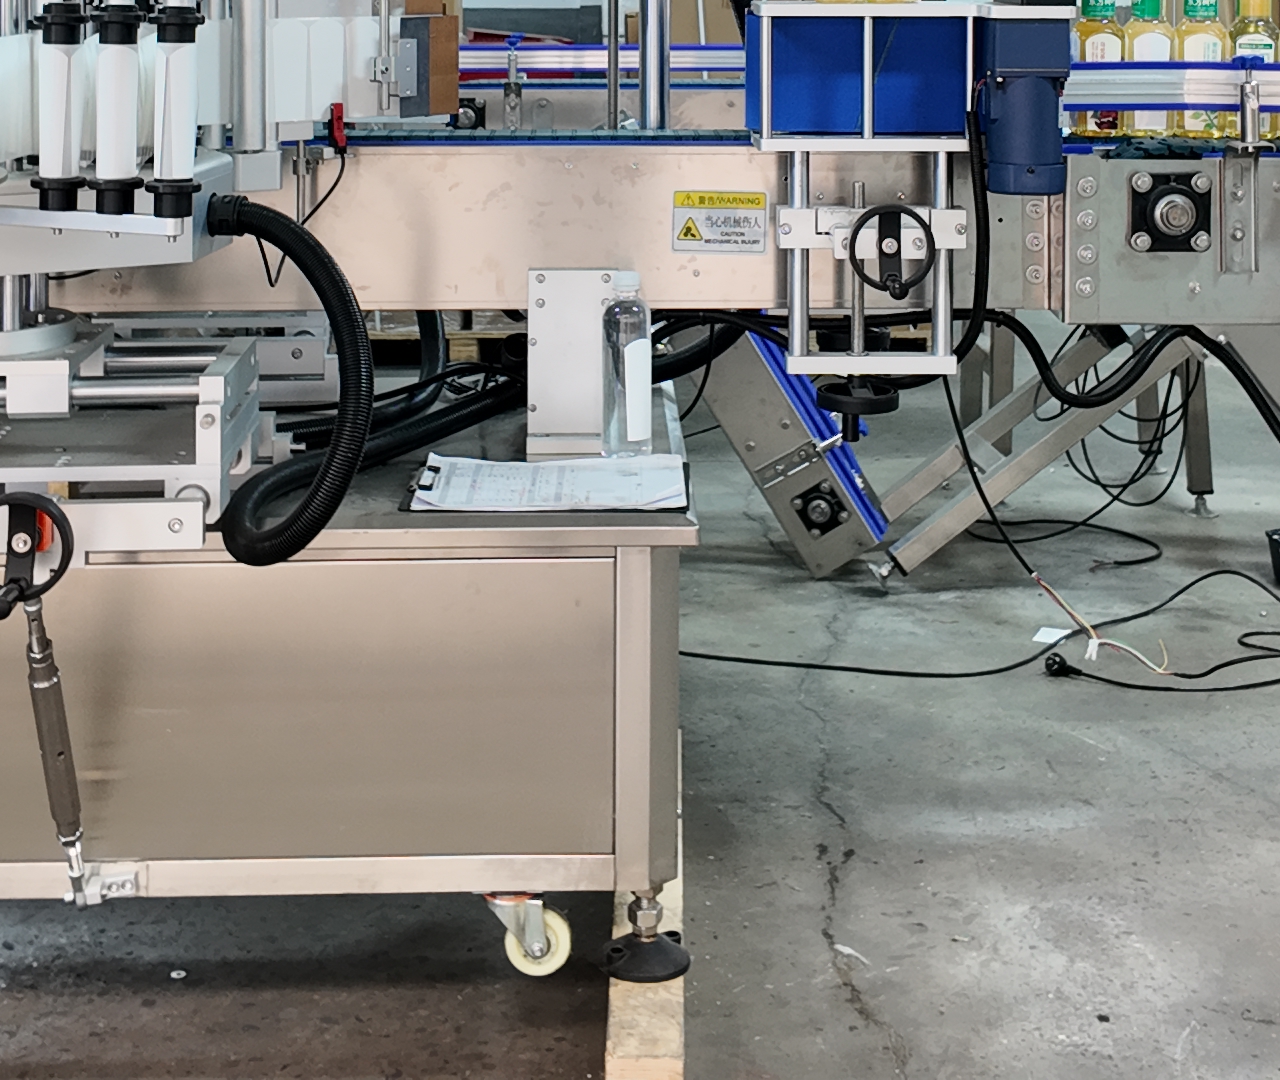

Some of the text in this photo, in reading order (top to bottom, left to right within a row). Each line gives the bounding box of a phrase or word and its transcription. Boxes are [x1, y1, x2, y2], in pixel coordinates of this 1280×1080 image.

[704, 215, 761, 230] 当心机械伤人
